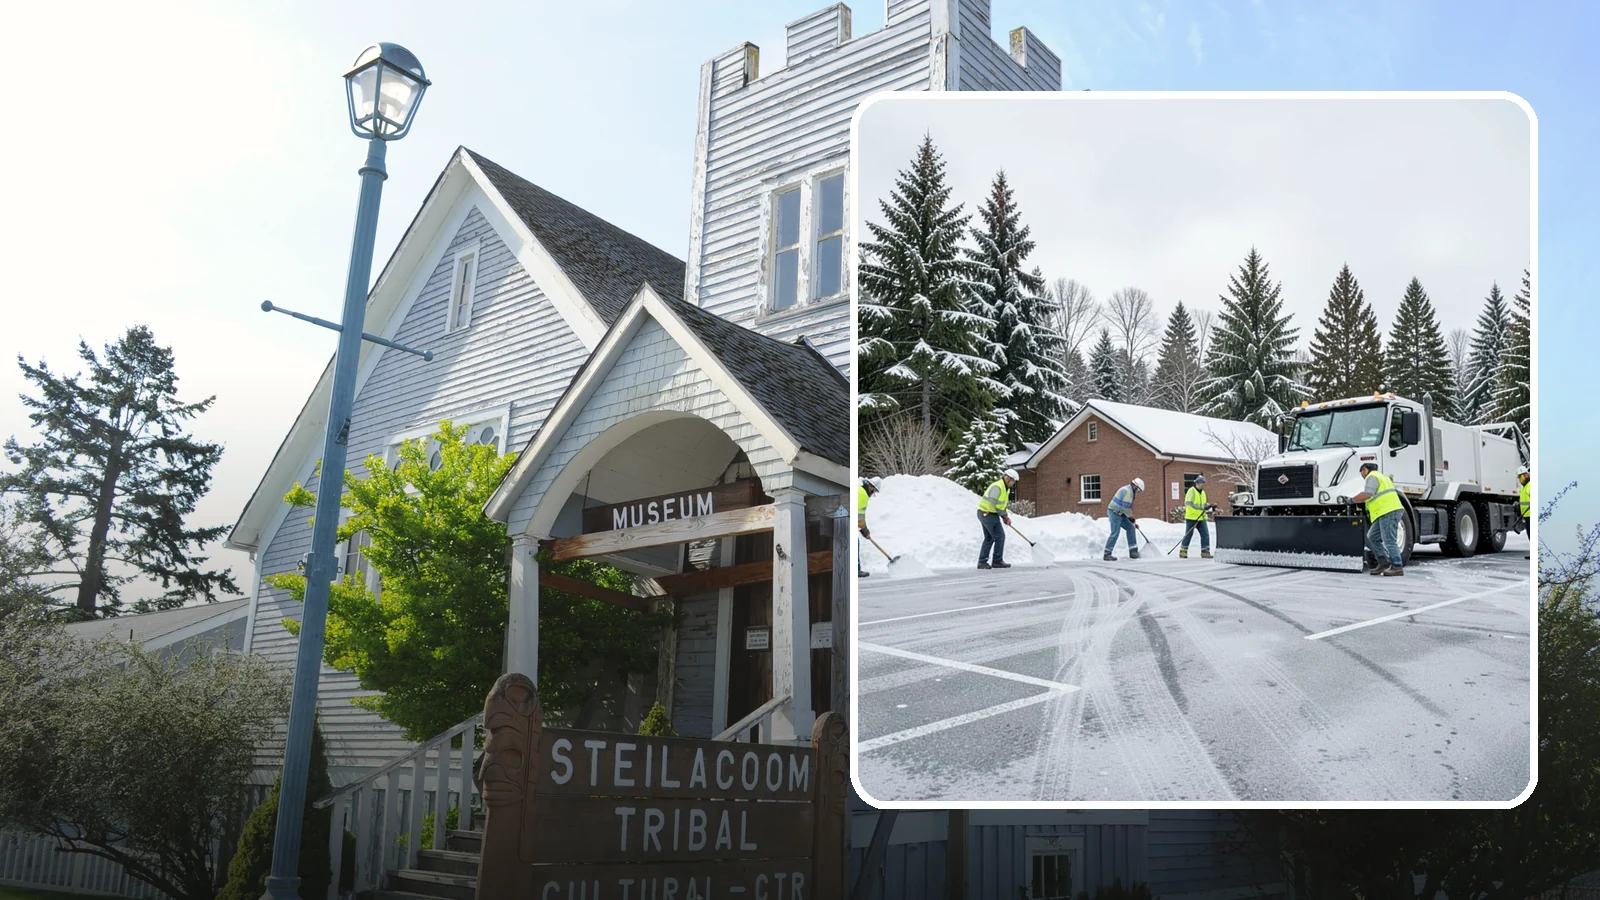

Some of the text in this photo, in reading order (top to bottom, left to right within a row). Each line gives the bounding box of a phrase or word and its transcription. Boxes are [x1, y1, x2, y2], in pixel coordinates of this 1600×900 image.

[612, 491, 714, 530] MUSEUM
[550, 738, 809, 792] STEILACOOM
[615, 807, 758, 852] TRIBAL
